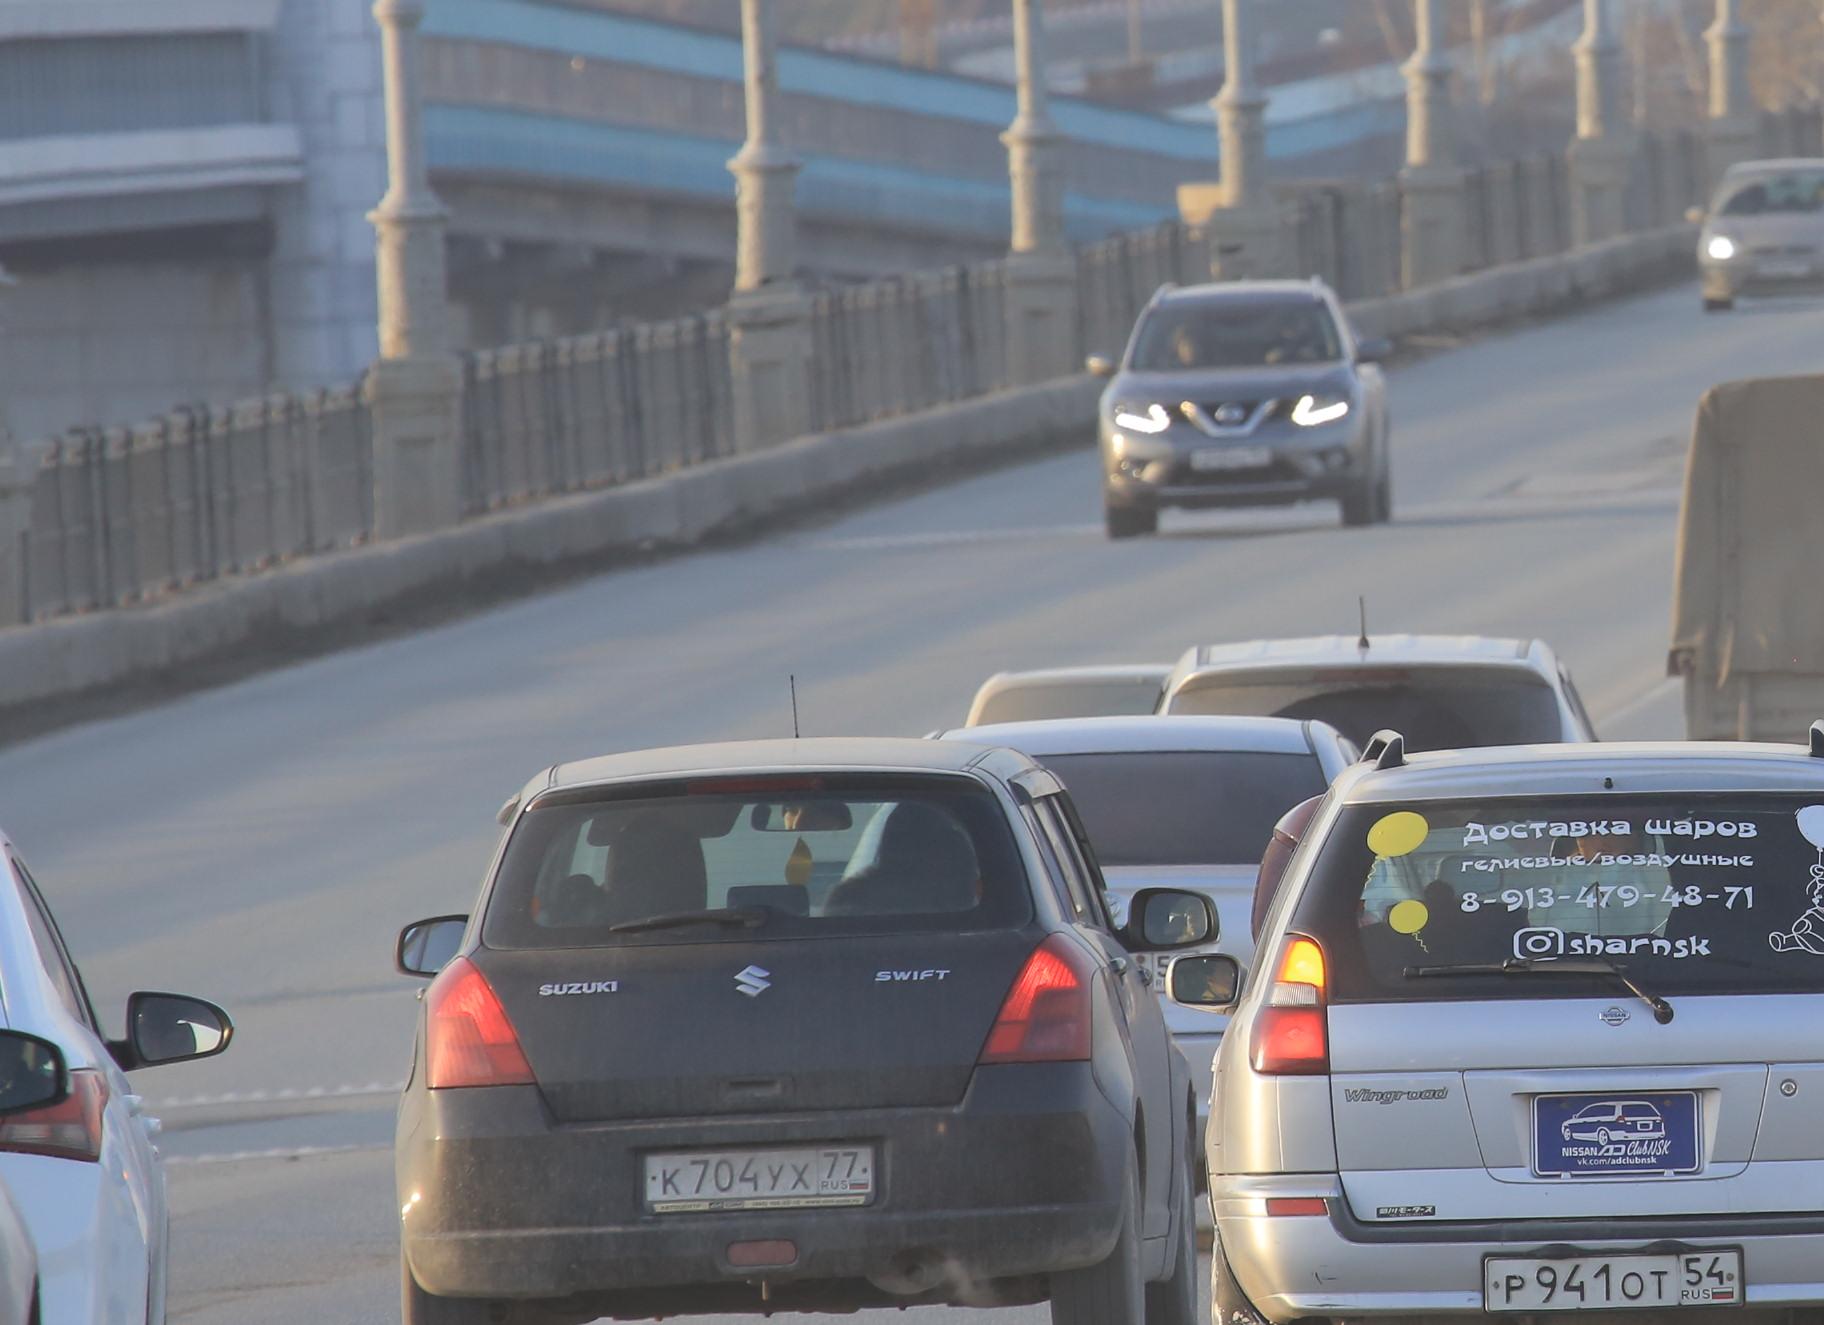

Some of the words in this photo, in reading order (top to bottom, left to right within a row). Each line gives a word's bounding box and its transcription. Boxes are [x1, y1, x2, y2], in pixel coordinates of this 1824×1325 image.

[1463, 819, 1632, 847] Доставка
[1644, 818, 1758, 840] шаров
[1460, 885, 1754, 912] 8-913-479-48-71
[874, 969, 951, 982] SWIFT
[538, 981, 619, 996] SUZUKI
[1344, 1086, 1449, 1105] Wingroad
[1562, 1146, 1598, 1157] NISSAN
[823, 1151, 858, 1179] 77
[1576, 1155, 1657, 1167] vk.com/adclubnsk
[820, 1179, 848, 1191] RUS
[1685, 1256, 1724, 1287] 54
[1681, 1288, 1711, 1300] RUS
